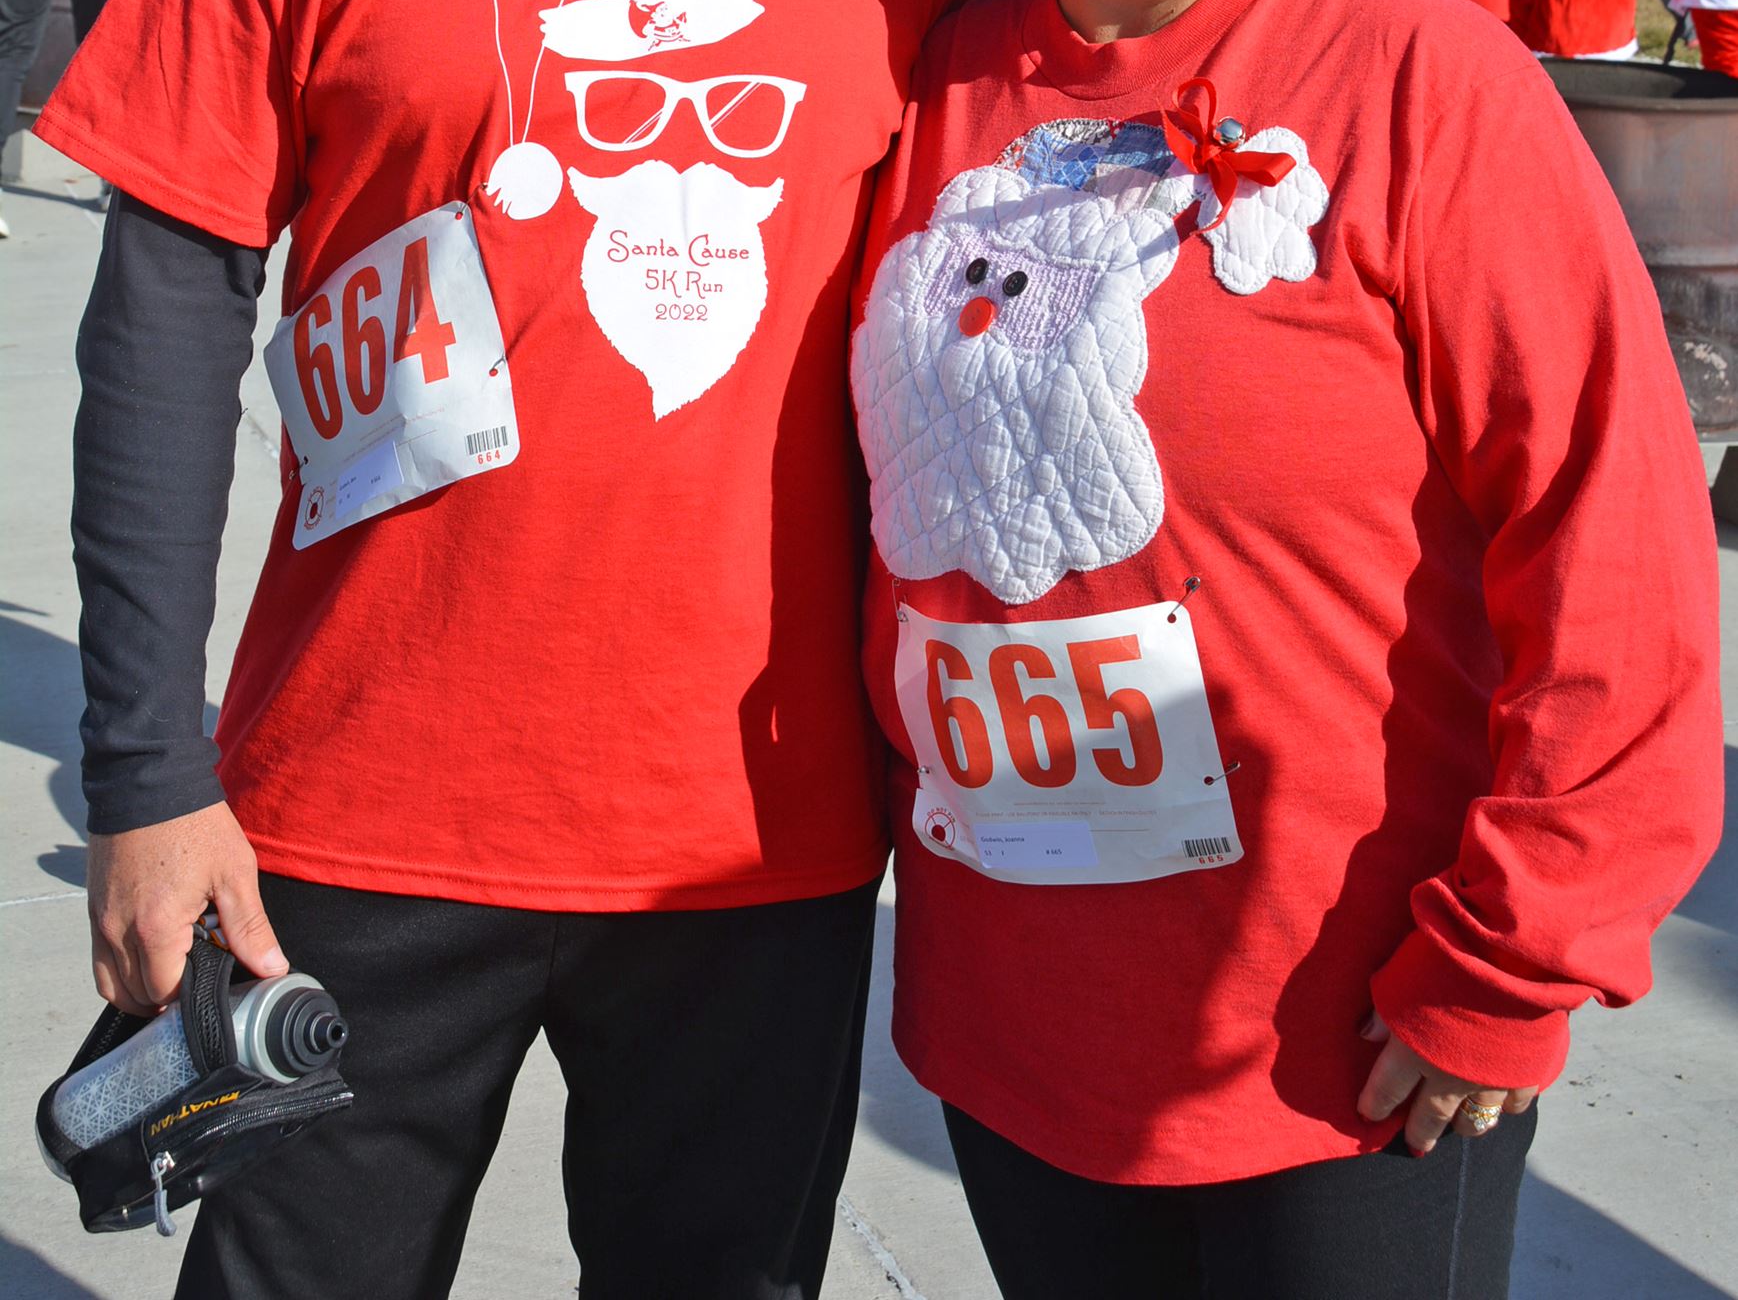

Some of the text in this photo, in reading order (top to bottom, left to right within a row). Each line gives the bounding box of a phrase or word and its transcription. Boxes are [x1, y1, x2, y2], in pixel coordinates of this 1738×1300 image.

[607, 229, 750, 267] Santa Cause
[645, 268, 723, 300] 5K Run
[655, 303, 708, 322] 2022
[294, 236, 457, 440] 664
[477, 449, 501, 465] 664
[925, 634, 1164, 790] 665
[1198, 854, 1225, 865] 665
